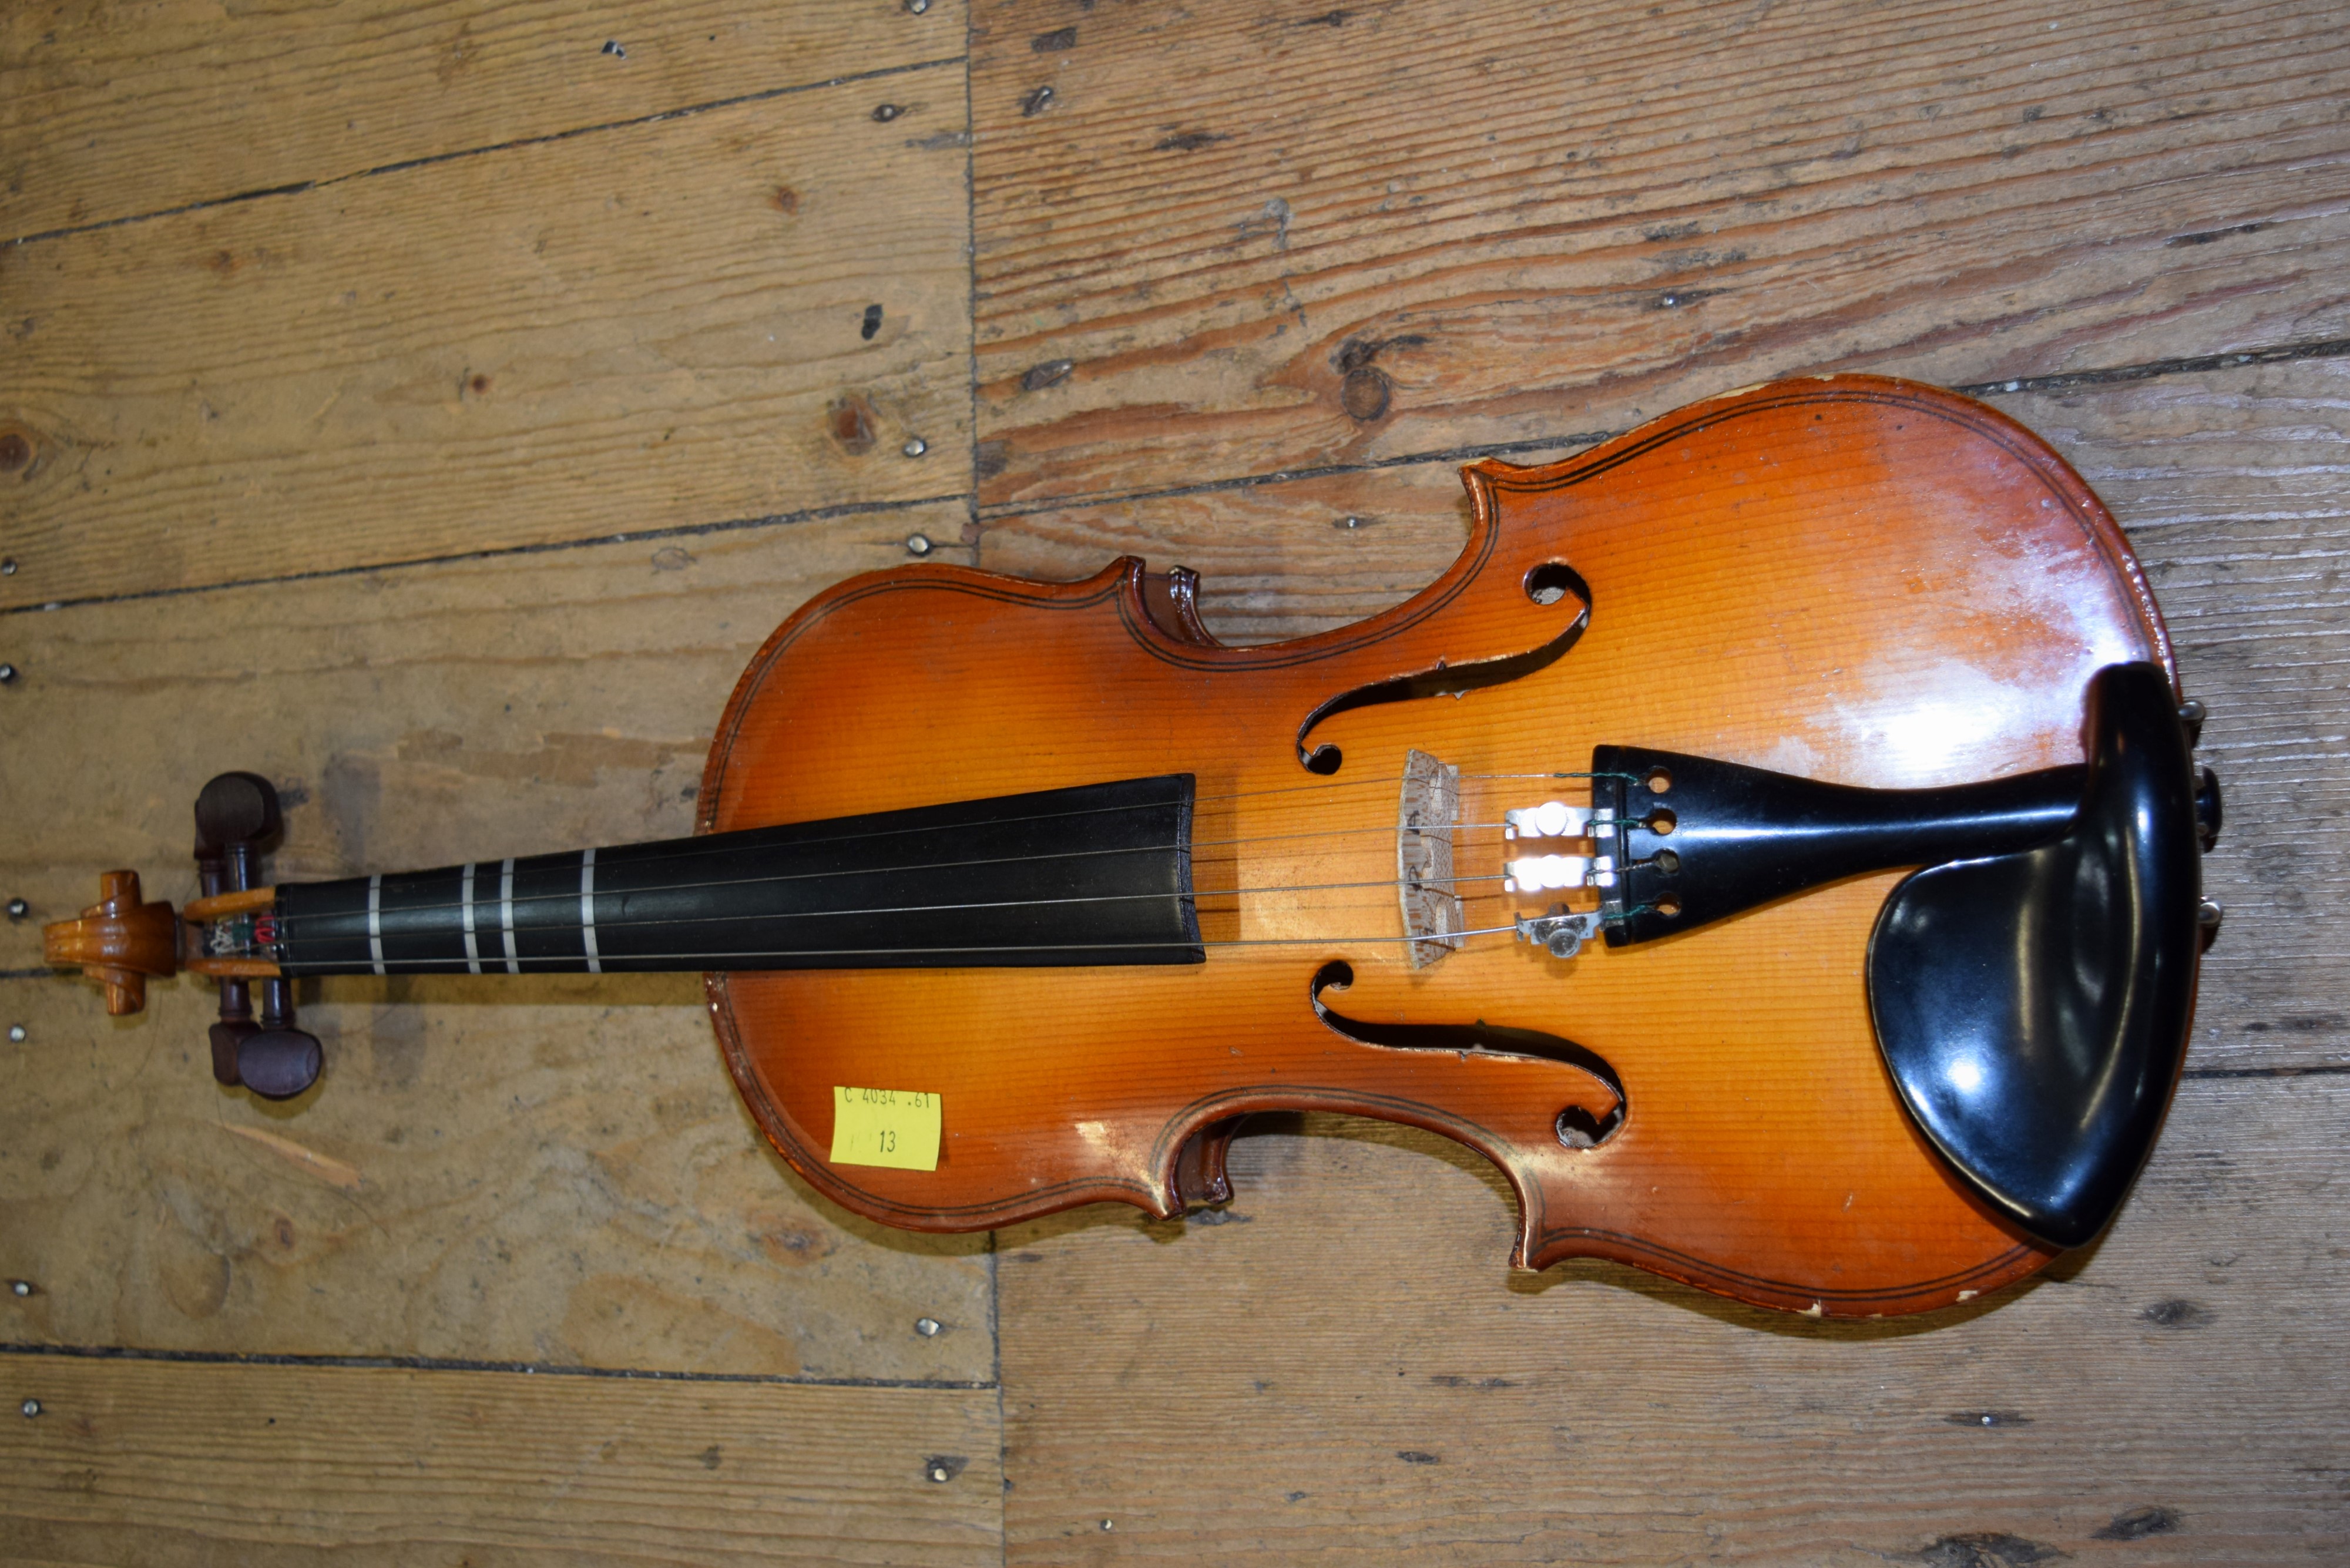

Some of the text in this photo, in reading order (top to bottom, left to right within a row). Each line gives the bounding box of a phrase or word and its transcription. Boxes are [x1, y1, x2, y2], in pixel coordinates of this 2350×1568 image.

[844, 1087, 852, 1103] C
[862, 1088, 896, 1106] 4034
[880, 1130, 896, 1153] 13
